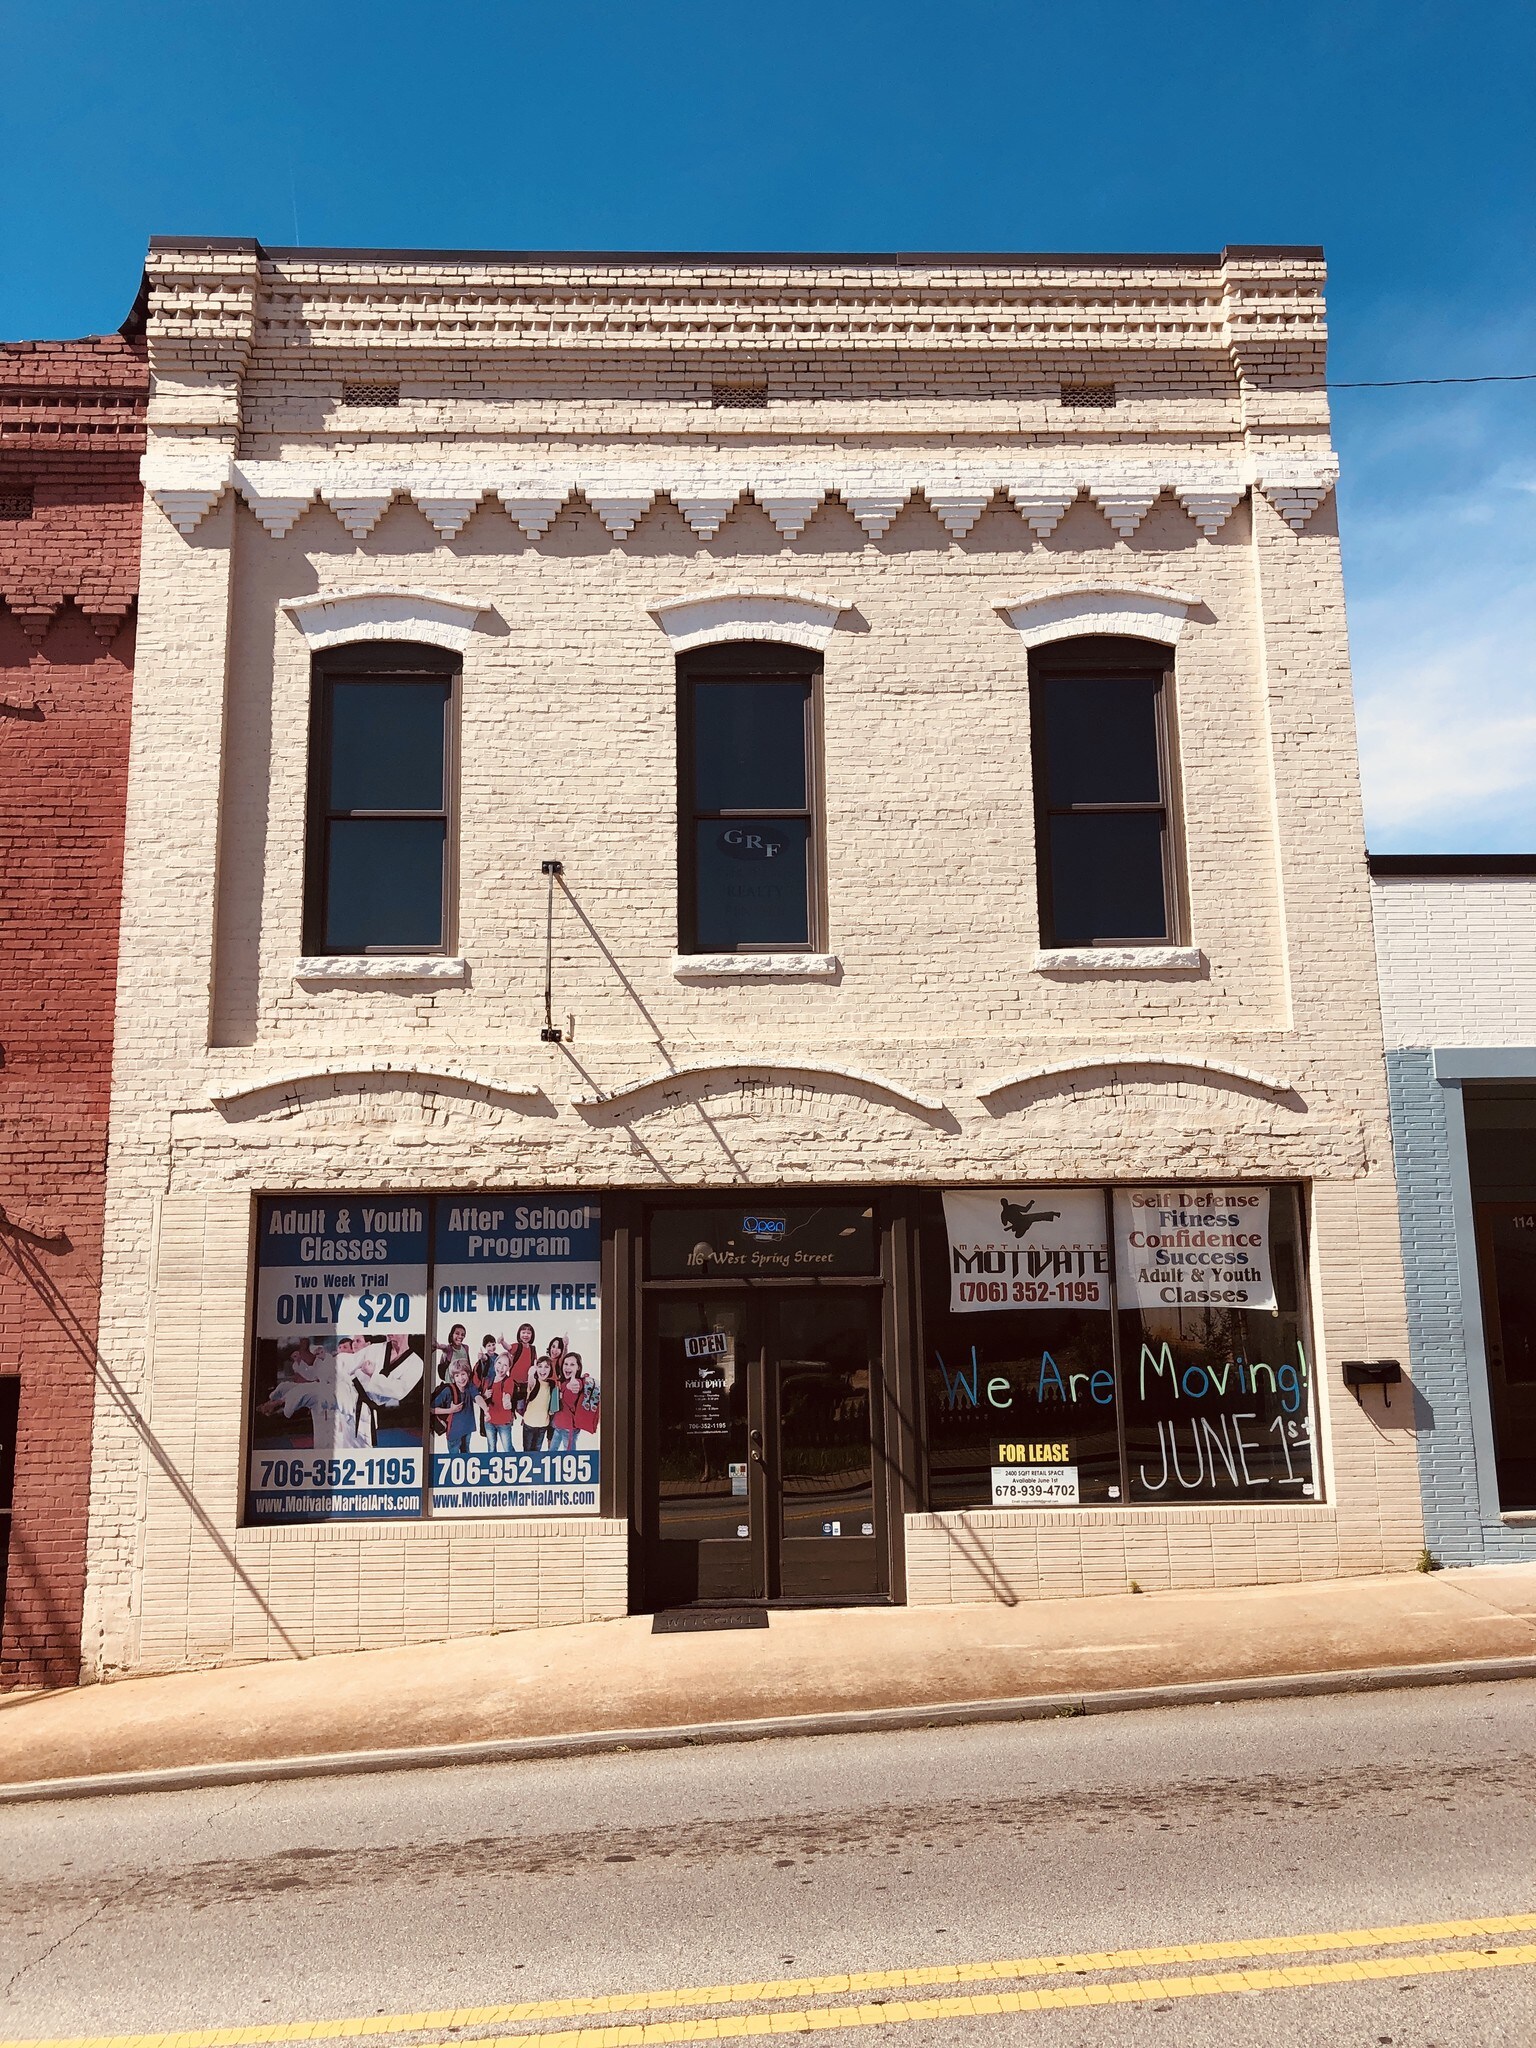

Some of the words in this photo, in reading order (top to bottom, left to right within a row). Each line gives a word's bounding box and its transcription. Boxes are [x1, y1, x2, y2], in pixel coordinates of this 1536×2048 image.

[724, 829, 780, 857] GRF
[1132, 1193, 1170, 1208] Self
[1178, 1192, 1260, 1208] Defense
[269, 1210, 325, 1234] Adult
[336, 1209, 350, 1233] &
[362, 1208, 423, 1232] Youth
[448, 1208, 504, 1231] After
[515, 1206, 590, 1230] School
[744, 1216, 784, 1233] Open
[1159, 1209, 1240, 1227] Fitness
[1512, 1216, 1534, 1228] 114
[468, 1235, 570, 1258] Program
[959, 1243, 1050, 1251] MARTIAL
[1060, 1243, 1108, 1251] ARTS
[1129, 1230, 1261, 1248] Confidence
[300, 1237, 388, 1261] Classes
[687, 1251, 704, 1266] 116
[708, 1251, 747, 1265] West
[751, 1250, 790, 1267] Spring
[794, 1250, 835, 1263] Street
[1156, 1249, 1248, 1265] Success
[953, 1246, 1109, 1279] MOTIVATE
[295, 1275, 318, 1288] Two
[324, 1274, 355, 1287] Week
[361, 1274, 388, 1287] Trial
[1138, 1269, 1183, 1282] Adult
[1191, 1268, 1204, 1282] &
[1211, 1268, 1261, 1282] Youth
[438, 1285, 477, 1313] ONE
[487, 1284, 540, 1311] WEEK
[550, 1283, 596, 1310] FREE
[959, 1282, 1008, 1302] (706)
[1012, 1281, 1099, 1302] 352-1195
[1160, 1287, 1249, 1303] Classes
[276, 1293, 344, 1324] ONLY
[357, 1289, 410, 1328] $20
[688, 1335, 725, 1355] OPEN
[936, 1346, 1012, 1408] We
[1038, 1351, 1114, 1404] Are
[1140, 1341, 1308, 1412] Moving!
[688, 1422, 727, 1430] 706-352-1195
[999, 1444, 1026, 1462] FOR
[1028, 1443, 1070, 1462] LEASE
[1140, 1413, 1269, 1490] JUNE
[260, 1458, 416, 1487] 706-352-1195
[437, 1455, 592, 1485] 706-352-1195
[433, 1489, 595, 1508] www.MotivateMartialArts.com
[995, 1485, 1075, 1496] 678-939-4702
[256, 1494, 420, 1513] www.MotivateMartialArts.com
